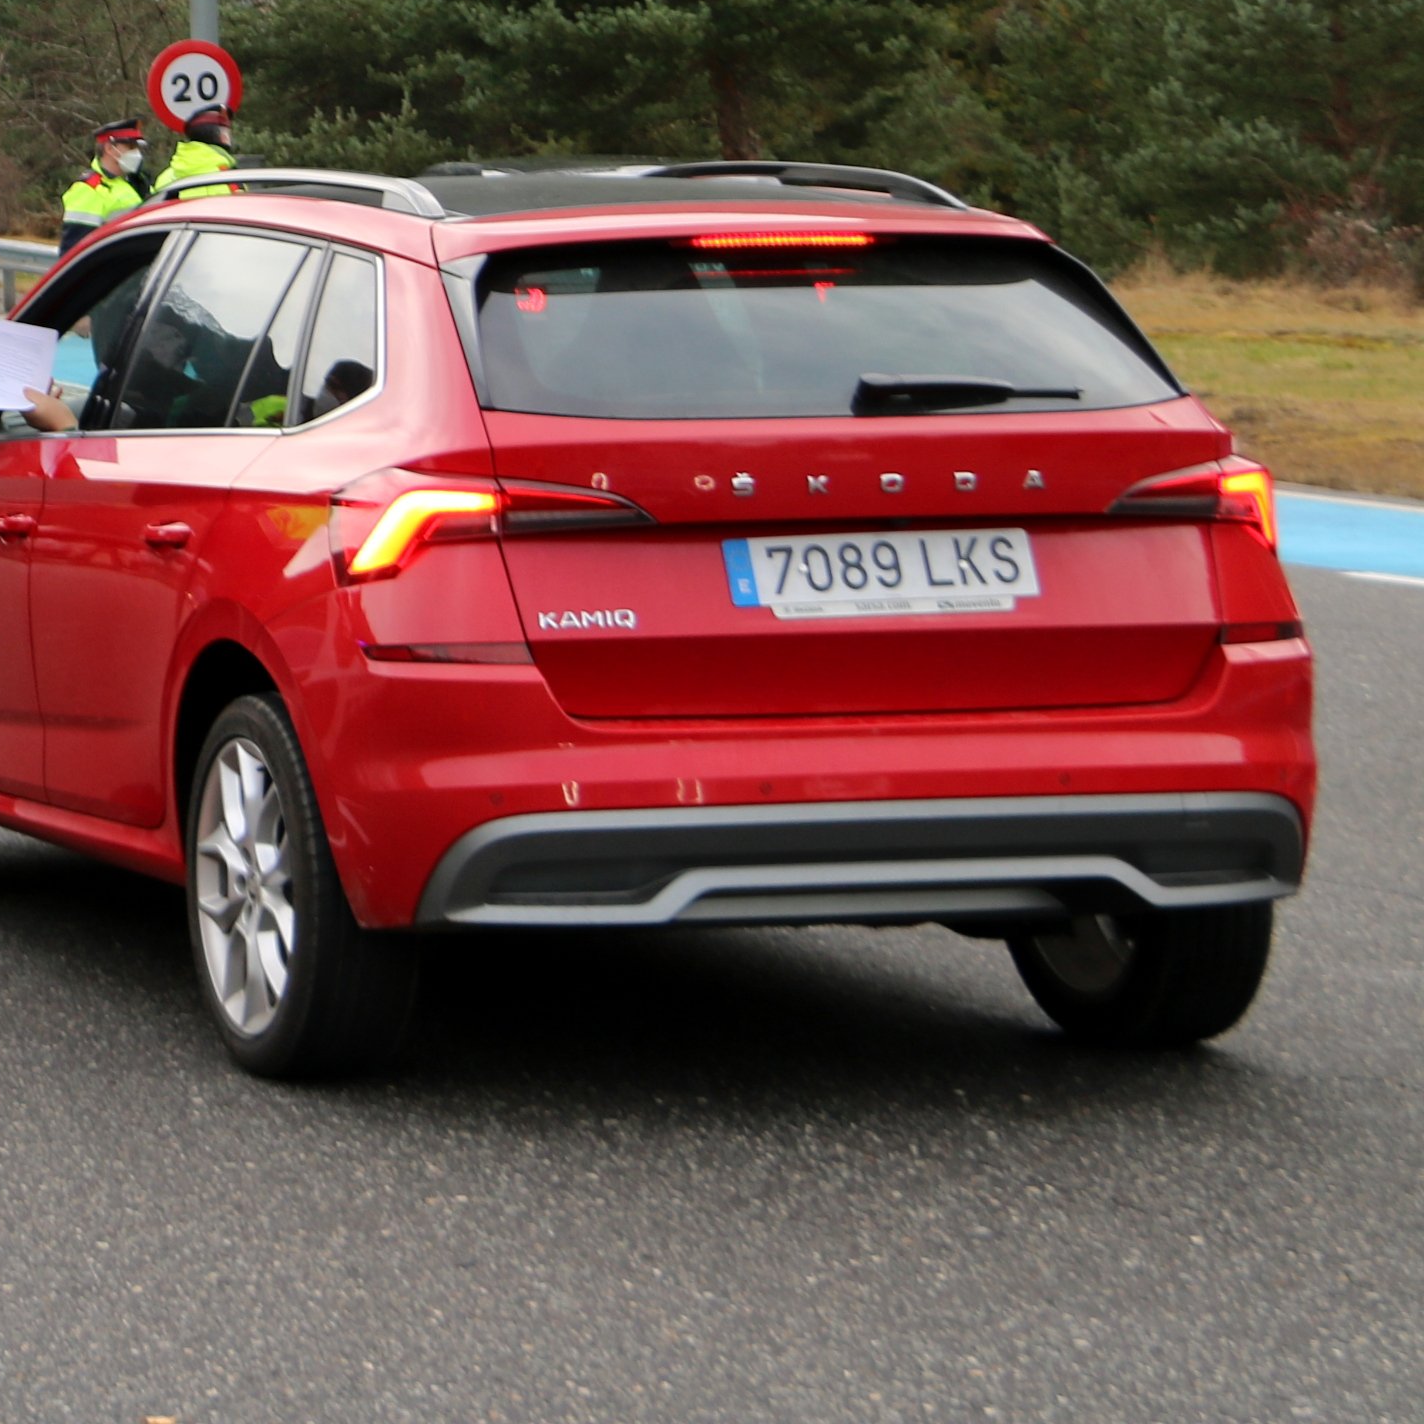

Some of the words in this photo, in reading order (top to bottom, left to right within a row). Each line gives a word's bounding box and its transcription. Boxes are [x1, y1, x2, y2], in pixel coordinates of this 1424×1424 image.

[171, 71, 218, 102] 20
[765, 538, 903, 596] 7089
[918, 535, 1022, 588] LKS
[537, 608, 638, 631] KAMIQ
